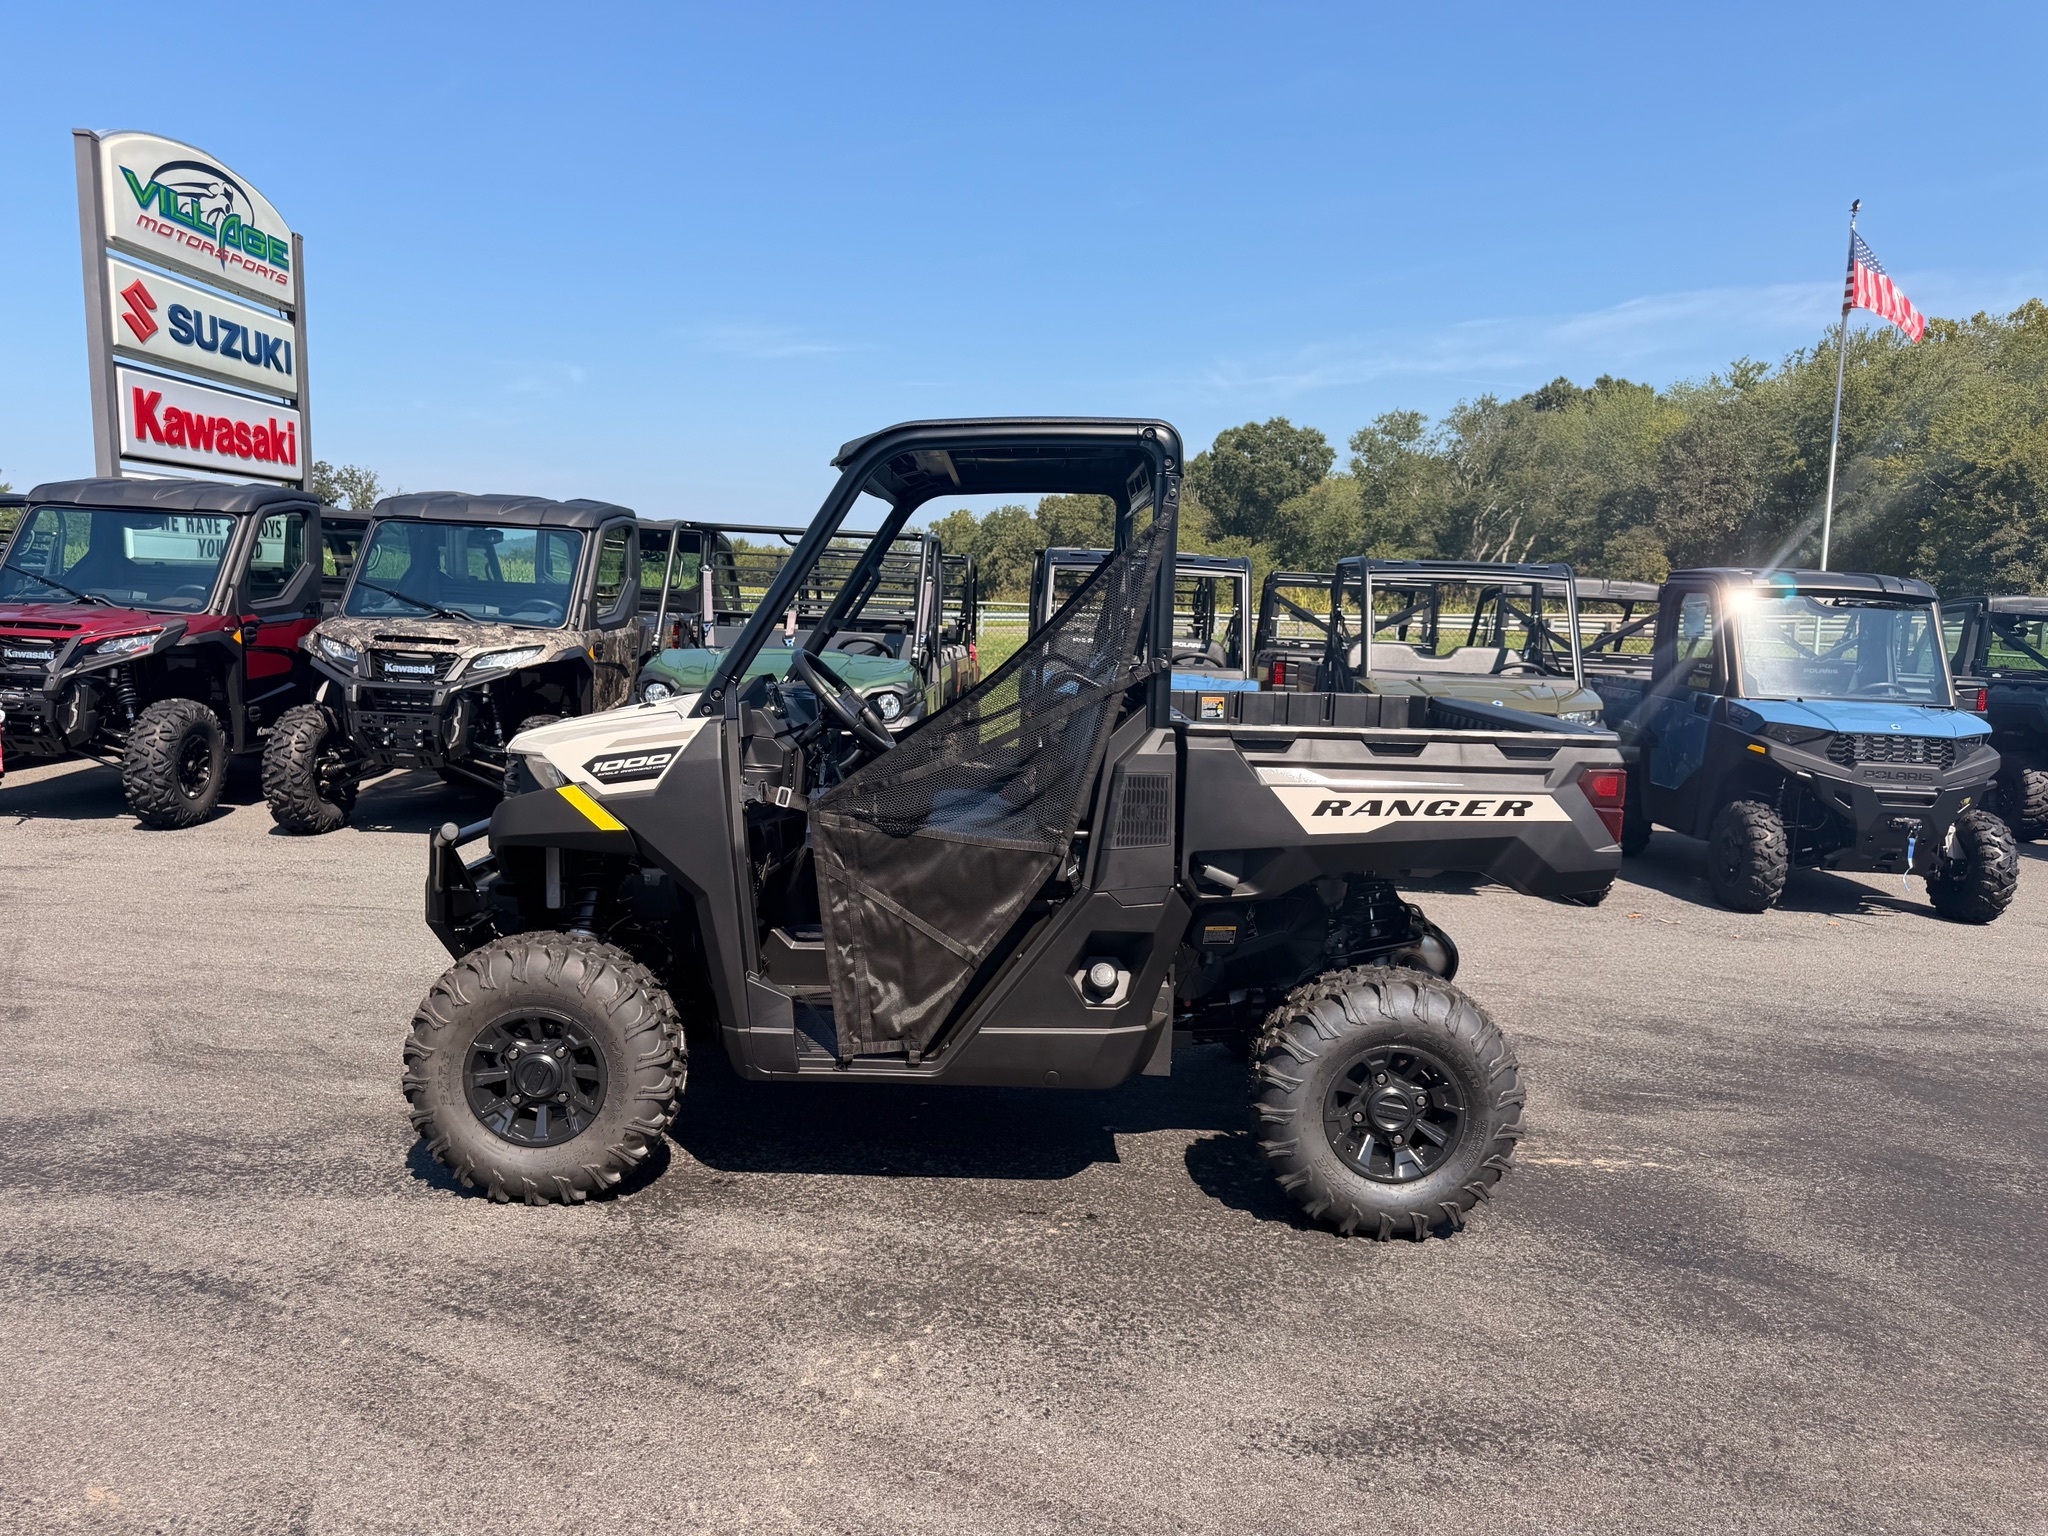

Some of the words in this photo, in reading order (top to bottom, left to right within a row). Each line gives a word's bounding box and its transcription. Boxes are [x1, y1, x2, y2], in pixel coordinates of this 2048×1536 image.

[119, 165, 289, 271] VILLAGE
[137, 214, 287, 285] MOTORSPORTS
[168, 303, 292, 374] SUZUKI
[132, 385, 296, 465] Kawasaki
[186, 517, 221, 535] HAVE
[4, 649, 54, 659] Kawasaki
[384, 662, 435, 674] Kawasaki
[592, 753, 672, 773] 1000
[1864, 769, 1933, 782] POLARIS
[1311, 799, 1534, 817] RANGER
